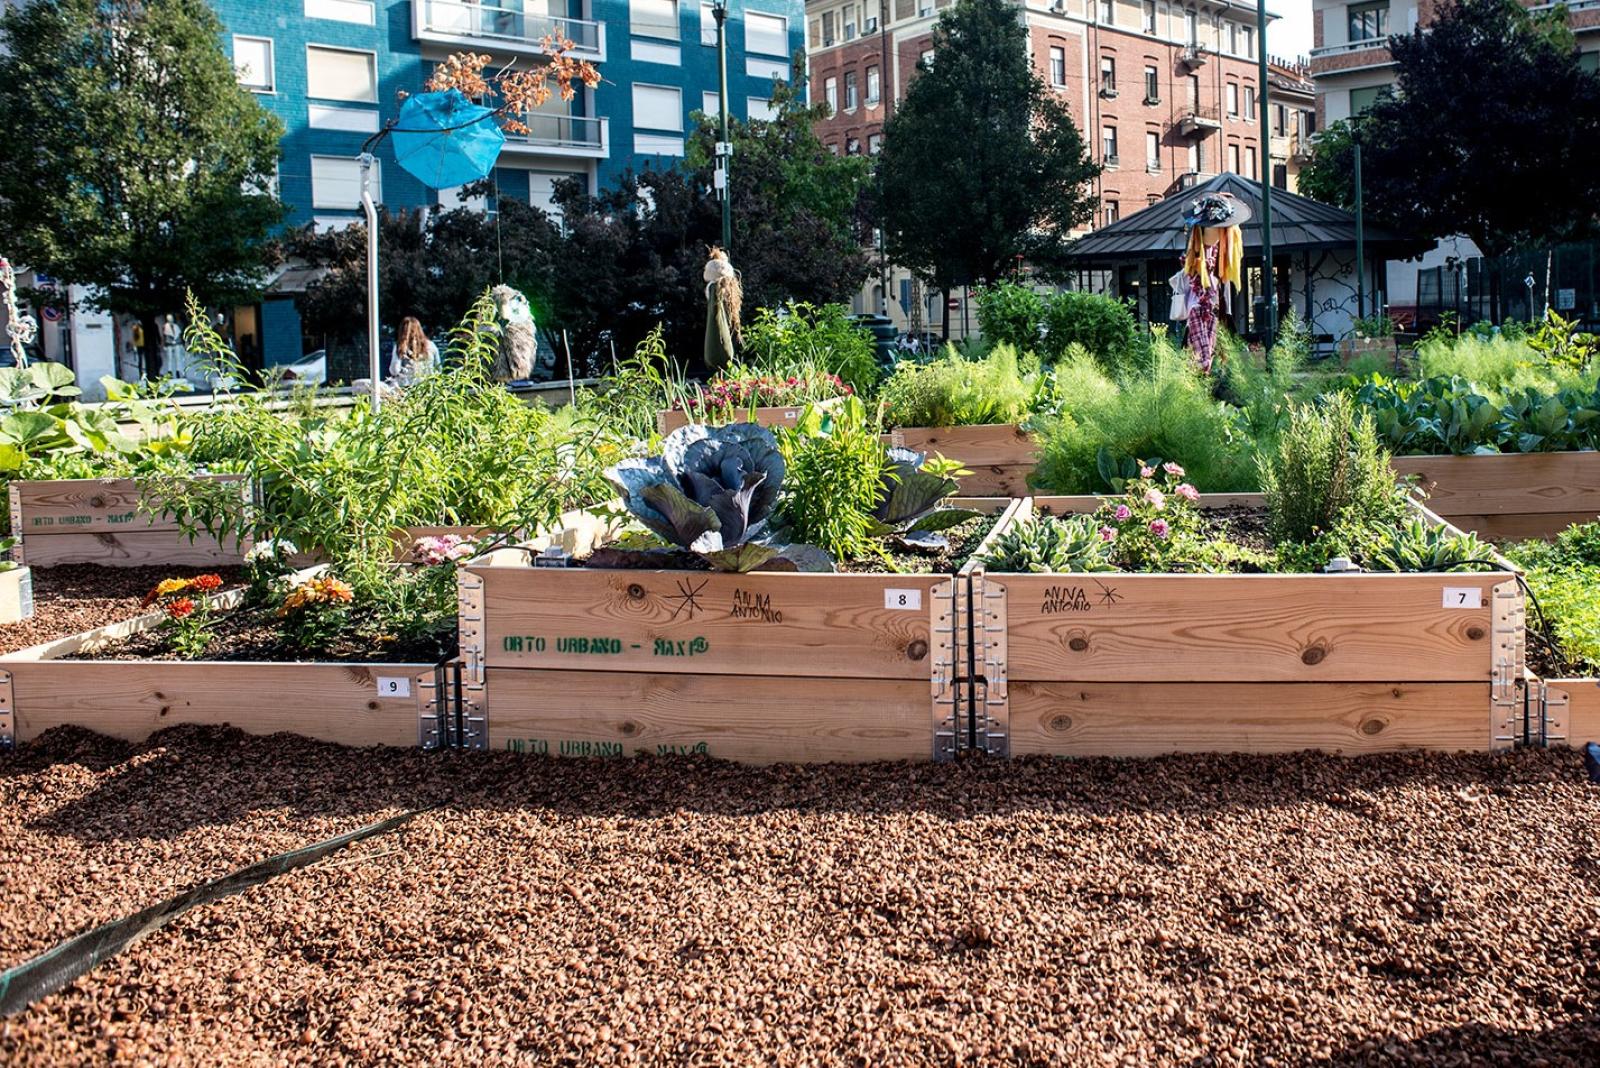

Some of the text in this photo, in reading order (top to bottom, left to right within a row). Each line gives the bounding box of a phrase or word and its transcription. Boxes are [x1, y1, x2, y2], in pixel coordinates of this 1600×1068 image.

[898, 593, 907, 606] 8
[1044, 586, 1086, 602] ANNA
[1458, 592, 1467, 605] 7
[730, 604, 783, 624] ANTONIO
[1041, 599, 1092, 614] ANTONIO
[503, 636, 546, 652] ORTO
[556, 637, 622, 655] URBANO
[389, 681, 398, 693] 9
[506, 739, 549, 754] ORTO
[559, 740, 623, 756] URBANO
